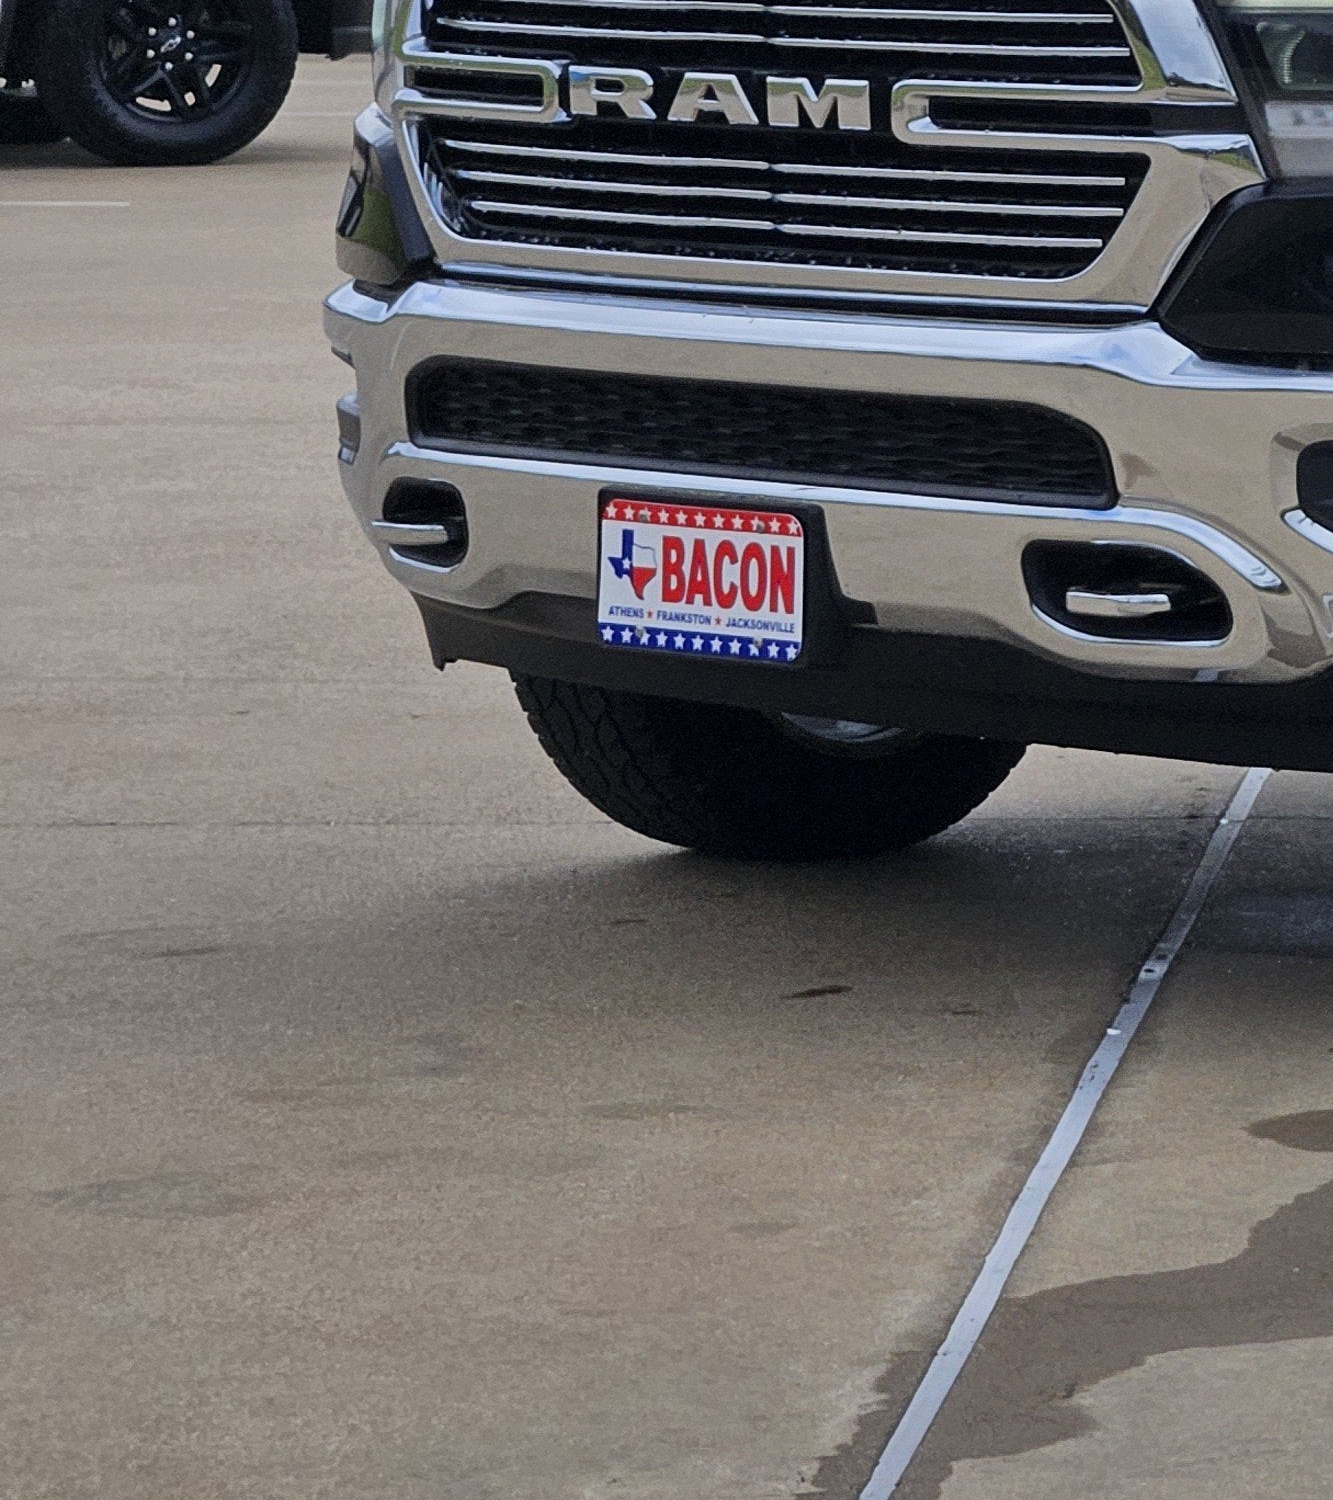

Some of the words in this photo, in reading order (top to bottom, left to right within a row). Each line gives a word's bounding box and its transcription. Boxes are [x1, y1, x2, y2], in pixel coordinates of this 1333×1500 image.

[568, 65, 871, 131] RAM
[661, 534, 796, 615] BACON
[608, 605, 644, 619] ATHENS
[656, 610, 712, 626] FRANKSTON
[725, 617, 795, 634] JACKSONVILLE
